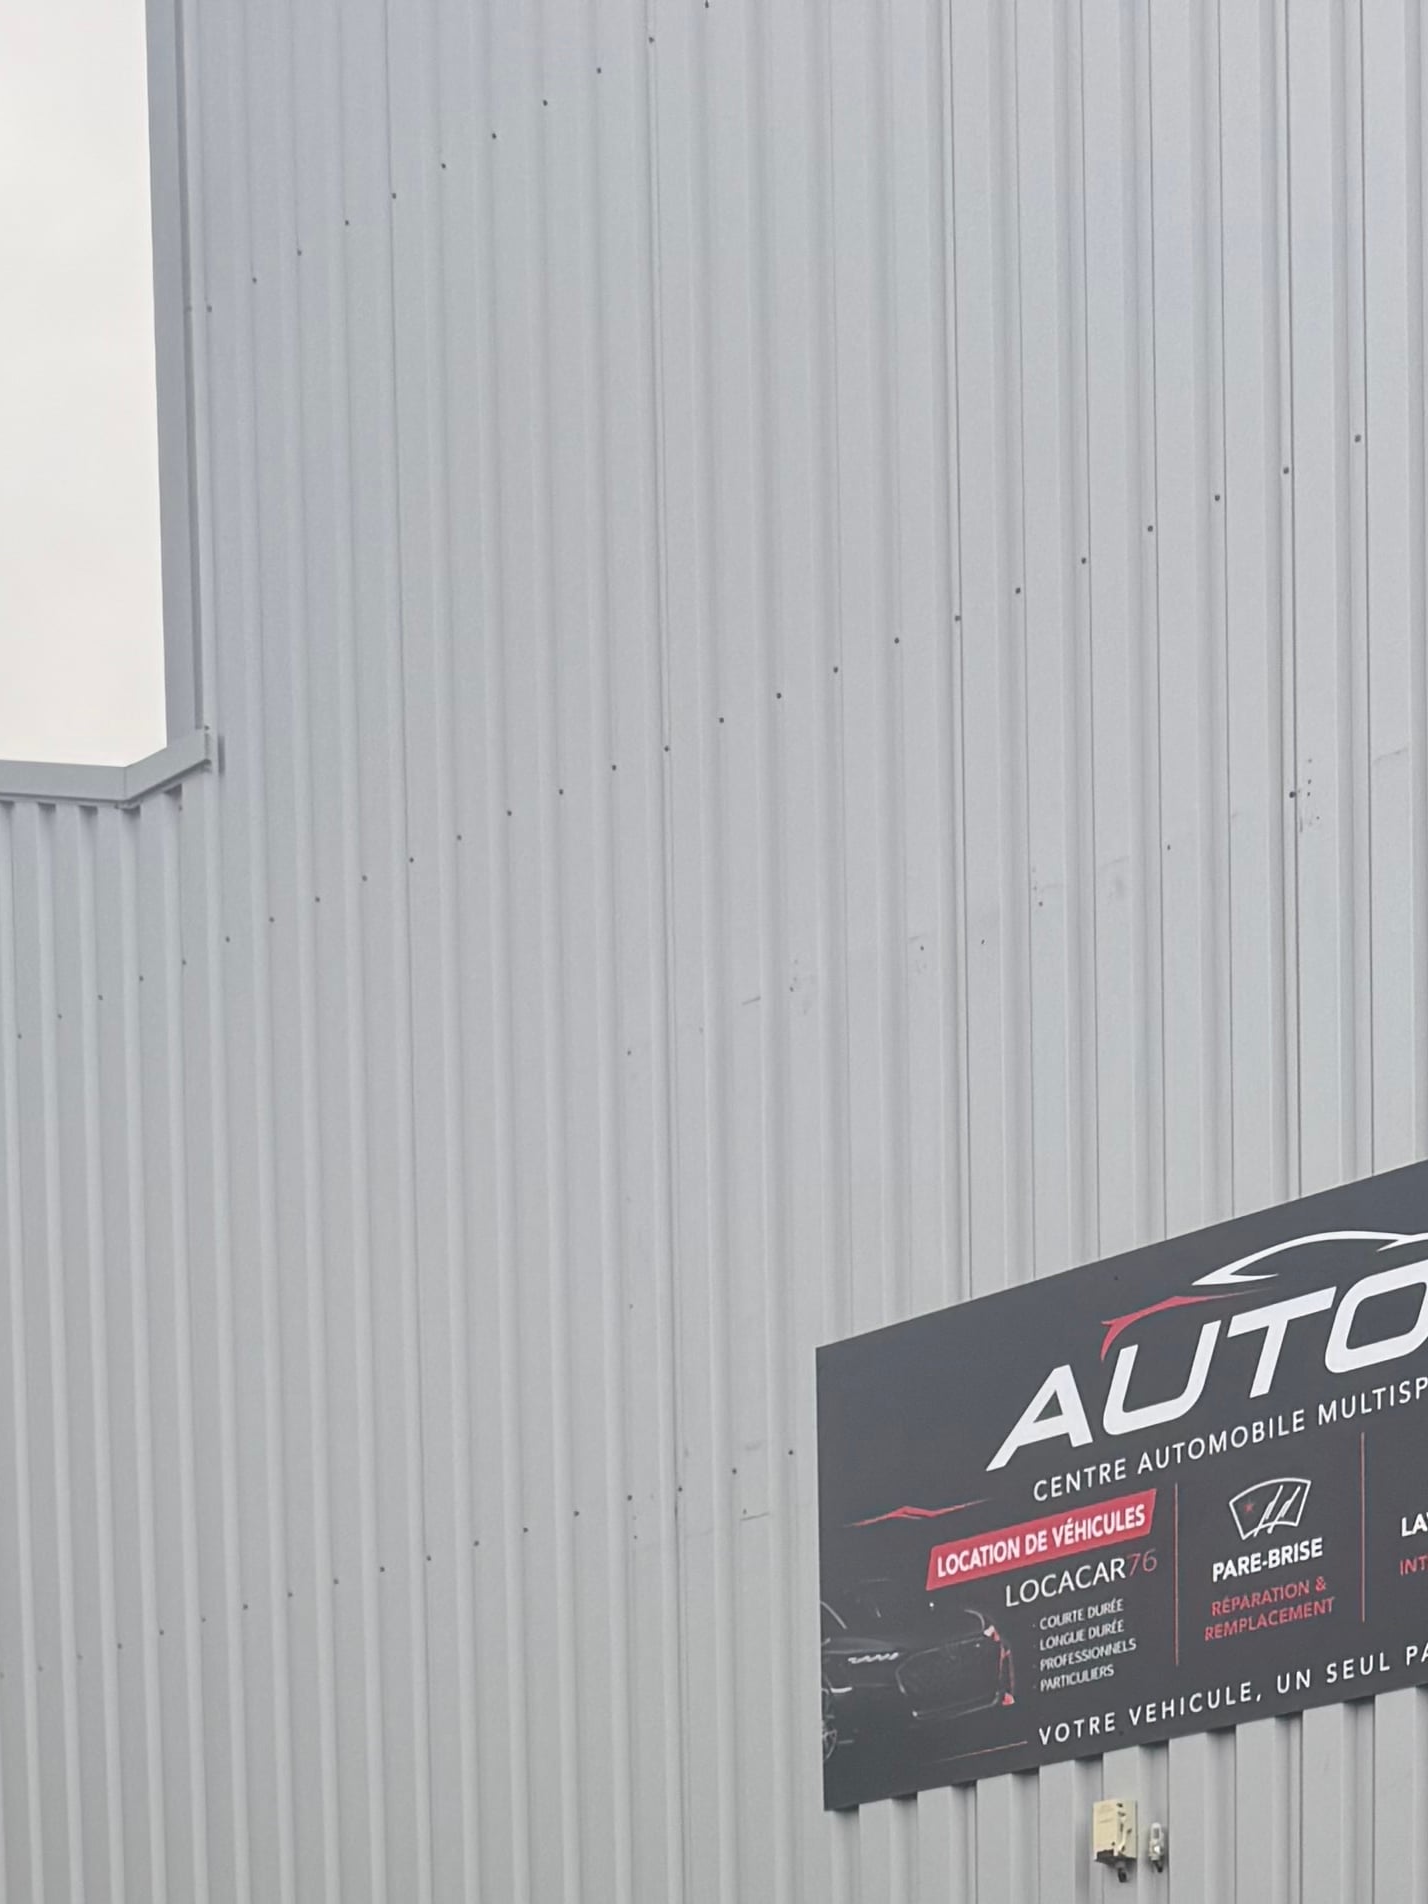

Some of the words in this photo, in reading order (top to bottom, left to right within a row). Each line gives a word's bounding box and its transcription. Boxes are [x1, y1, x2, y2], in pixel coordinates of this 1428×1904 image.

[1033, 1457, 1127, 1502] CENTRE
[1137, 1415, 1306, 1475] AUTOMOBILE
[936, 1535, 1021, 1578] LOCATION
[1025, 1531, 1048, 1556] DE
[1052, 1503, 1146, 1549] VÉHICULES
[1212, 1537, 1323, 1583] PARE-BRISE
[1005, 1549, 1158, 1607] LOCACAR76
[1211, 1578, 1309, 1617] RÉPARATION
[1314, 1576, 1327, 1593] &
[1039, 1604, 1085, 1631] COURTE
[1087, 1598, 1124, 1620] DURÉE
[1039, 1625, 1086, 1651] LONGUE
[1088, 1619, 1125, 1641] DURÉE
[1204, 1596, 1335, 1641] REMPLACEMENT
[1039, 1637, 1137, 1672] PROFESSIONNELS
[1038, 1711, 1116, 1746] VOTRE
[1128, 1681, 1262, 1726] VEHICULE,
[1276, 1668, 1311, 1694] UN
[1326, 1652, 1390, 1683] SEUL
[1039, 1664, 1114, 1692] PARTICULIERS
